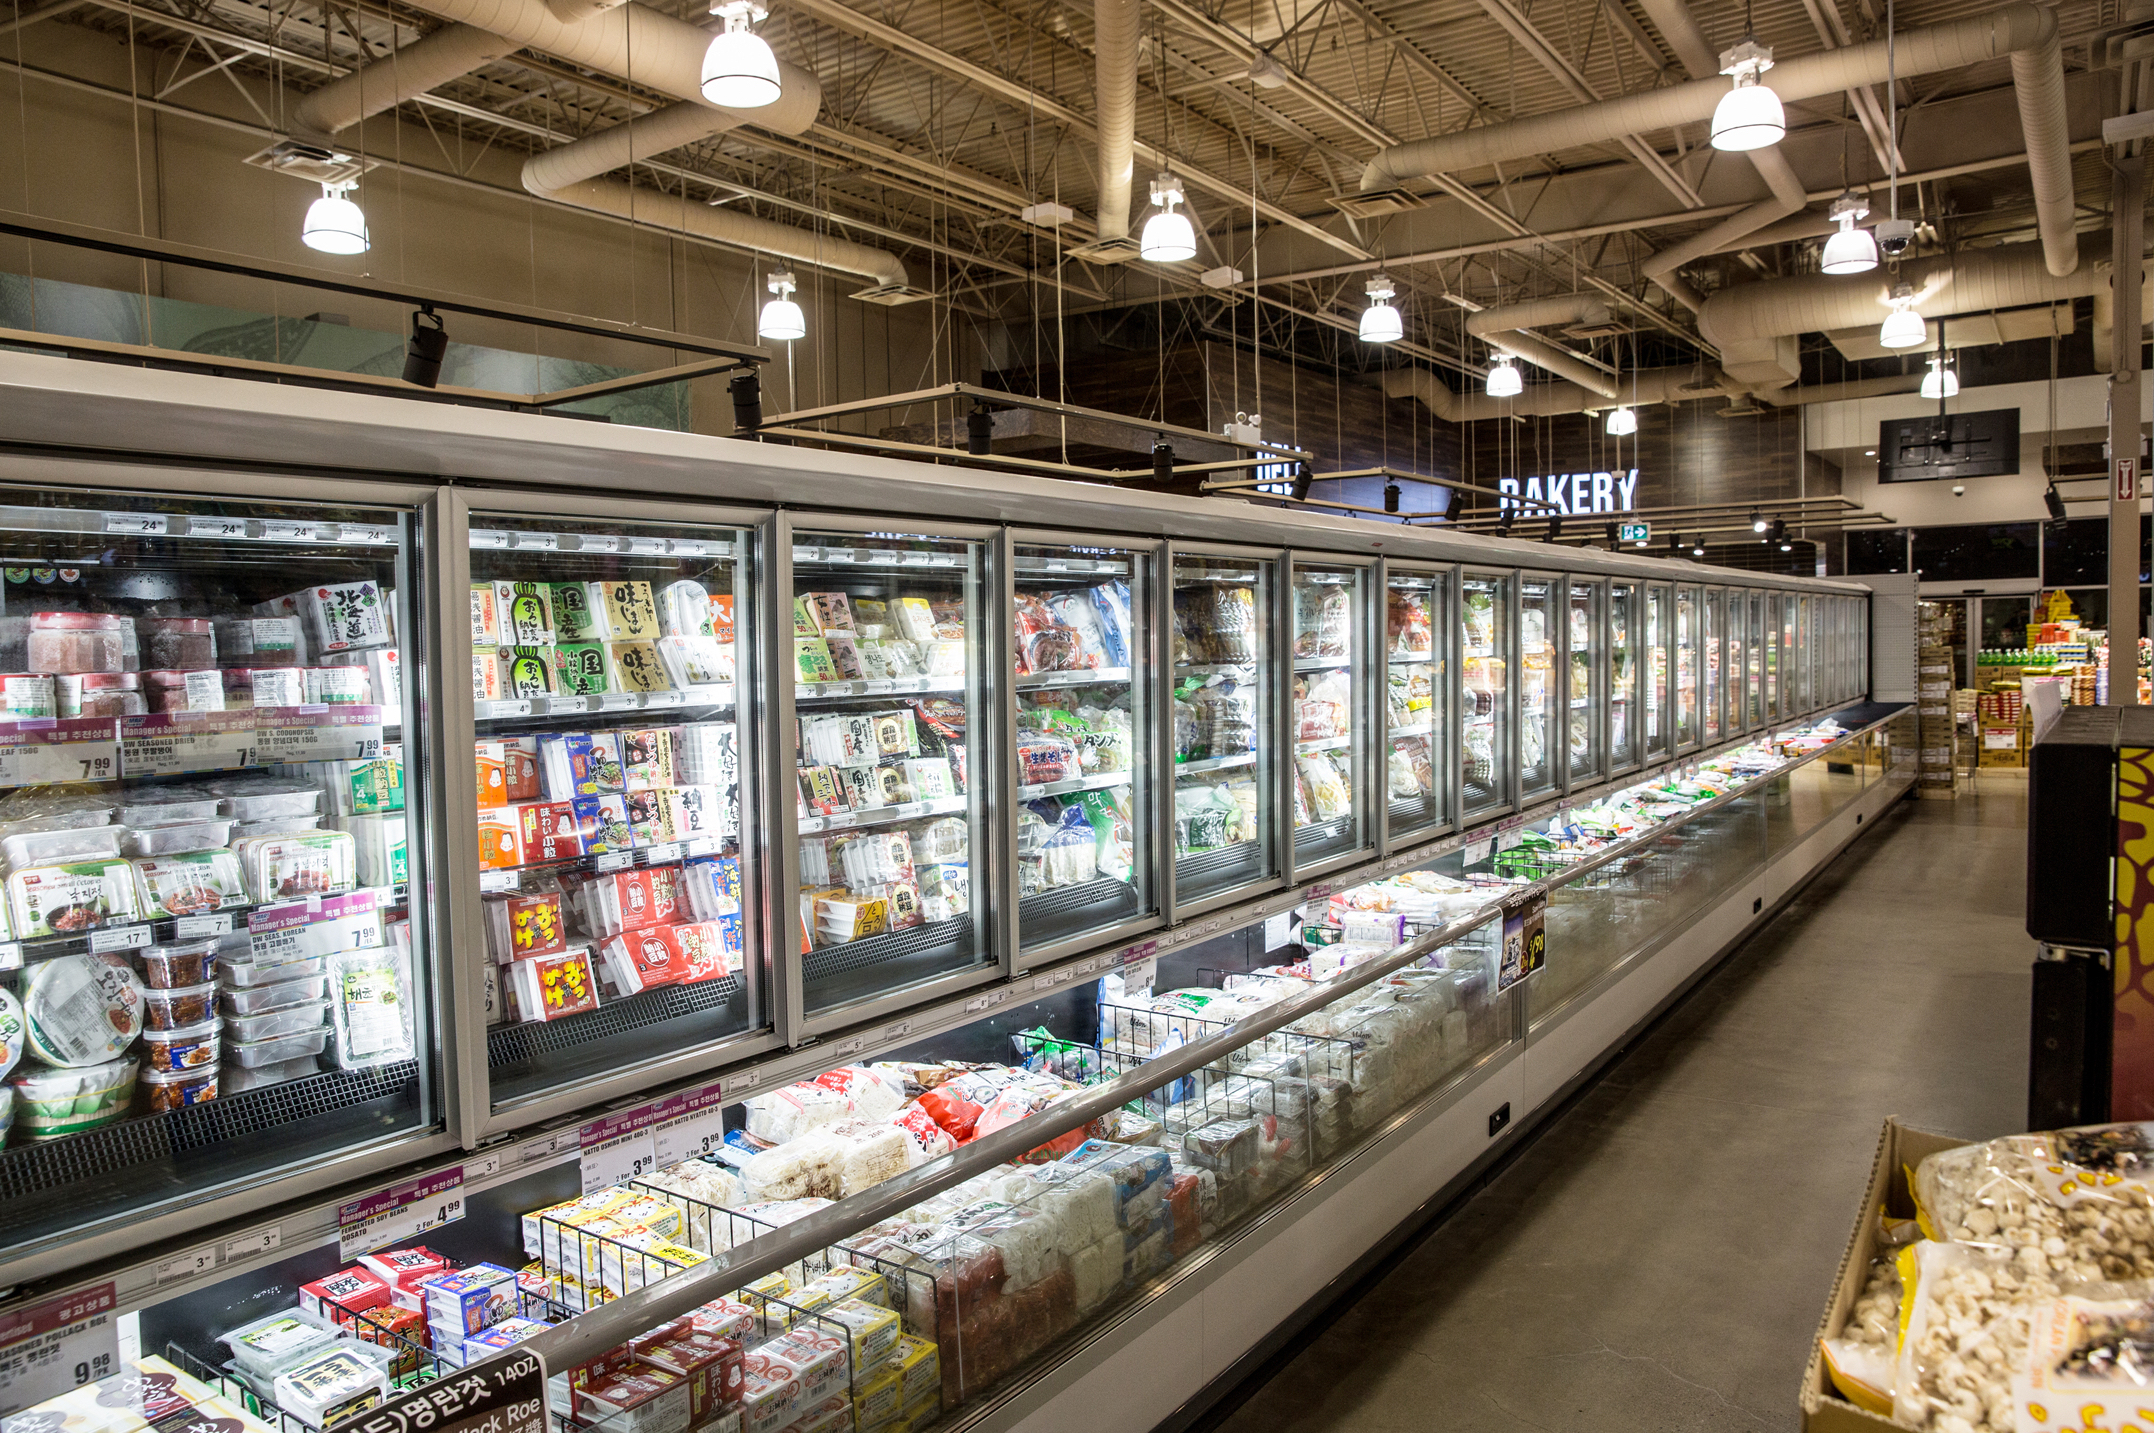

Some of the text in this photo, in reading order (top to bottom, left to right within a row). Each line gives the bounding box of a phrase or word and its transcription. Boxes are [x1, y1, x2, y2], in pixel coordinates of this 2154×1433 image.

[1500, 469, 1638, 518] BAKERY
[142, 521, 157, 531] 24
[222, 525, 236, 534] 24
[295, 527, 307, 537] 24
[368, 532, 380, 541] 24
[520, 704, 525, 712] 4
[576, 701, 581, 709] 3
[627, 698, 632, 706] 3
[292, 716, 316, 726] Special
[0, 733, 26, 746] pecial
[72, 728, 112, 740] 추천상품
[123, 726, 163, 737] Manager's
[163, 724, 191, 736] Special
[137, 739, 174, 749] SEASONED
[174, 738, 195, 747] DRIED
[355, 740, 379, 758] 7 99
[237, 748, 248, 767] 7
[79, 758, 111, 778] 7 99
[540, 807, 557, 858] 味わい小粒
[622, 856, 627, 864] 3
[670, 849, 675, 857] 3
[505, 876, 511, 885] 3
[215, 921, 223, 932] 7
[251, 920, 285, 933] Manager's
[286, 914, 311, 927] Special
[126, 932, 141, 945] 17
[283, 927, 307, 939] KOREAN
[352, 927, 376, 948] 7 99
[1536, 933, 1545, 953] 98
[653, 1107, 673, 1120] Manager's
[673, 1101, 687, 1113] Special
[700, 1091, 719, 1105] 추천상품
[656, 1120, 674, 1132] OSHIRO
[674, 1115, 689, 1126] NATTO
[690, 1109, 707, 1120] NYATTO
[581, 1129, 602, 1144] Manager's
[602, 1125, 618, 1137] Special
[702, 1136, 710, 1152] 3
[710, 1132, 719, 1143] 99
[550, 1141, 555, 1151] 3
[583, 1146, 599, 1157] NATTO
[600, 1138, 620, 1151] OSHIRO
[621, 1134, 633, 1144] MINI
[486, 1162, 493, 1171] 3
[621, 1172, 630, 1181] For
[633, 1160, 642, 1175] 3
[643, 1155, 653, 1166] 99
[341, 1206, 375, 1224] Manager's
[375, 1197, 399, 1213] Special
[431, 1175, 461, 1192] 추천상품
[341, 1206, 408, 1235] FERMENTED SOY BEANS
[422, 1219, 434, 1229] For
[437, 1206, 448, 1222] 4
[448, 1200, 460, 1213] 99
[263, 1235, 271, 1246] 3
[196, 1257, 204, 1268] 3
[59, 1295, 110, 1321] 광고상품
[0, 1338, 42, 1360] EASONED
[46, 1322, 87, 1343] POLLACK
[90, 1314, 108, 1328] ROE
[75, 1361, 90, 1385] 9
[92, 1353, 111, 1369] 98
[507, 1398, 541, 1426] Roe
